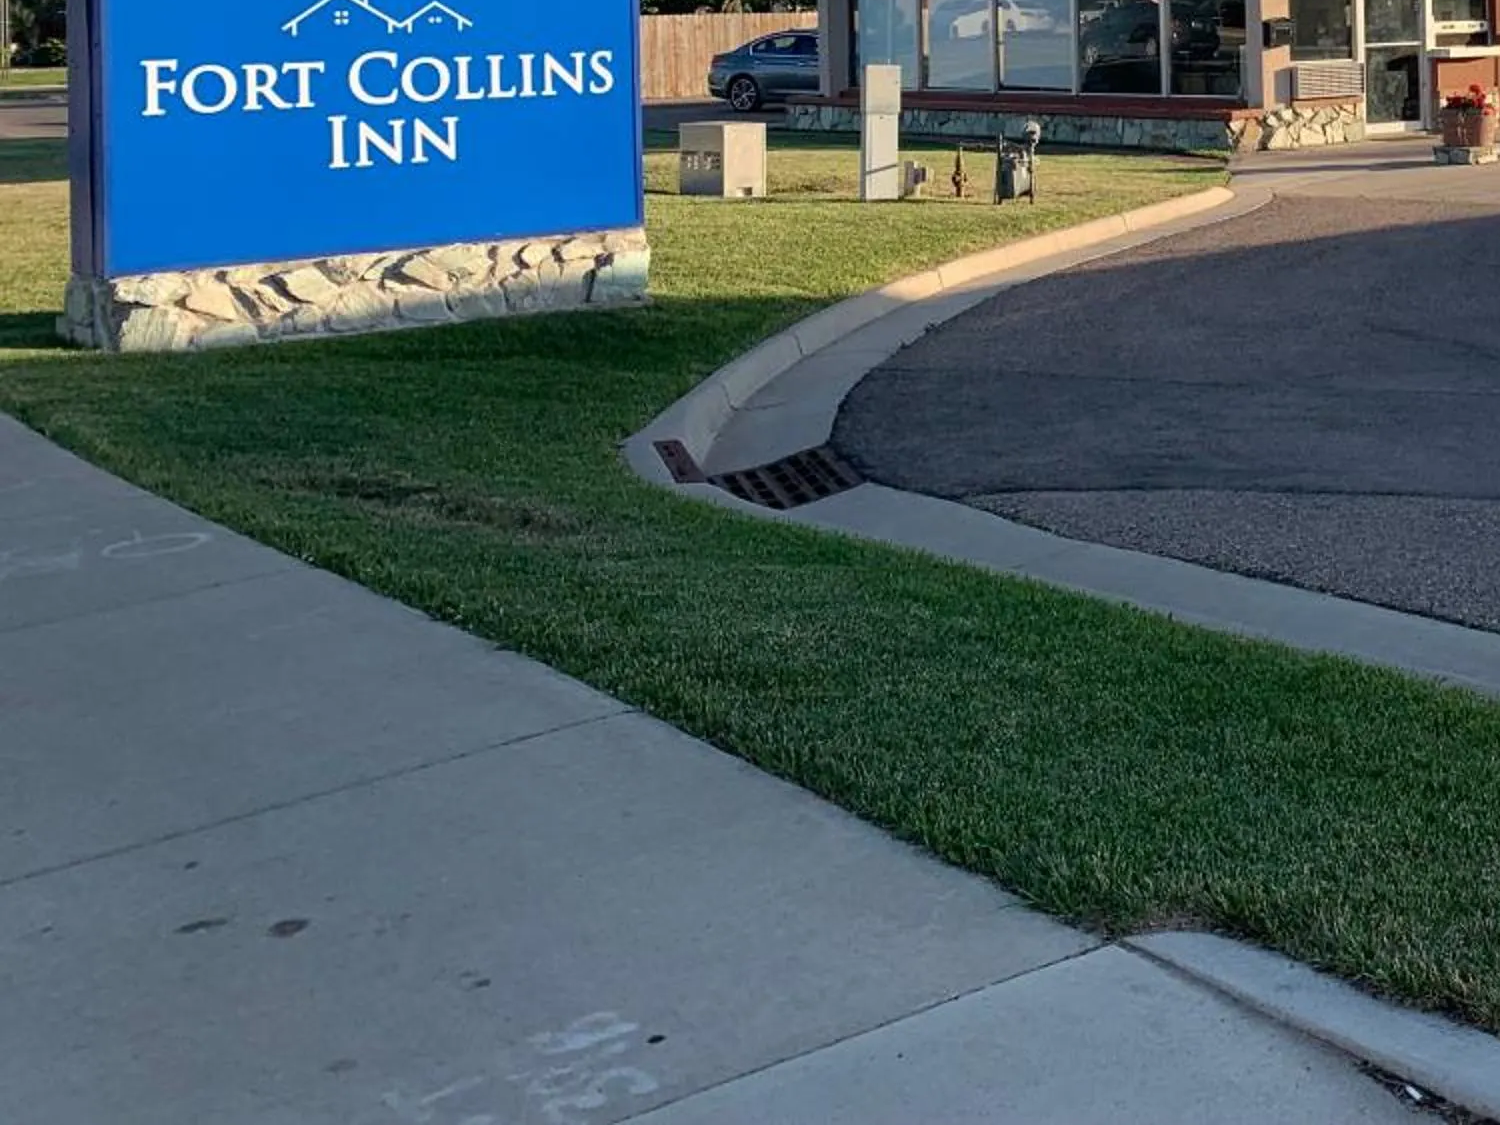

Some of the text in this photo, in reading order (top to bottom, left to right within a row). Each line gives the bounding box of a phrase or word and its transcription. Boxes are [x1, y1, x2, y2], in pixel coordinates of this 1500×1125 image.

[140, 50, 615, 117] FORT COLLINS
[328, 114, 459, 169] INN
